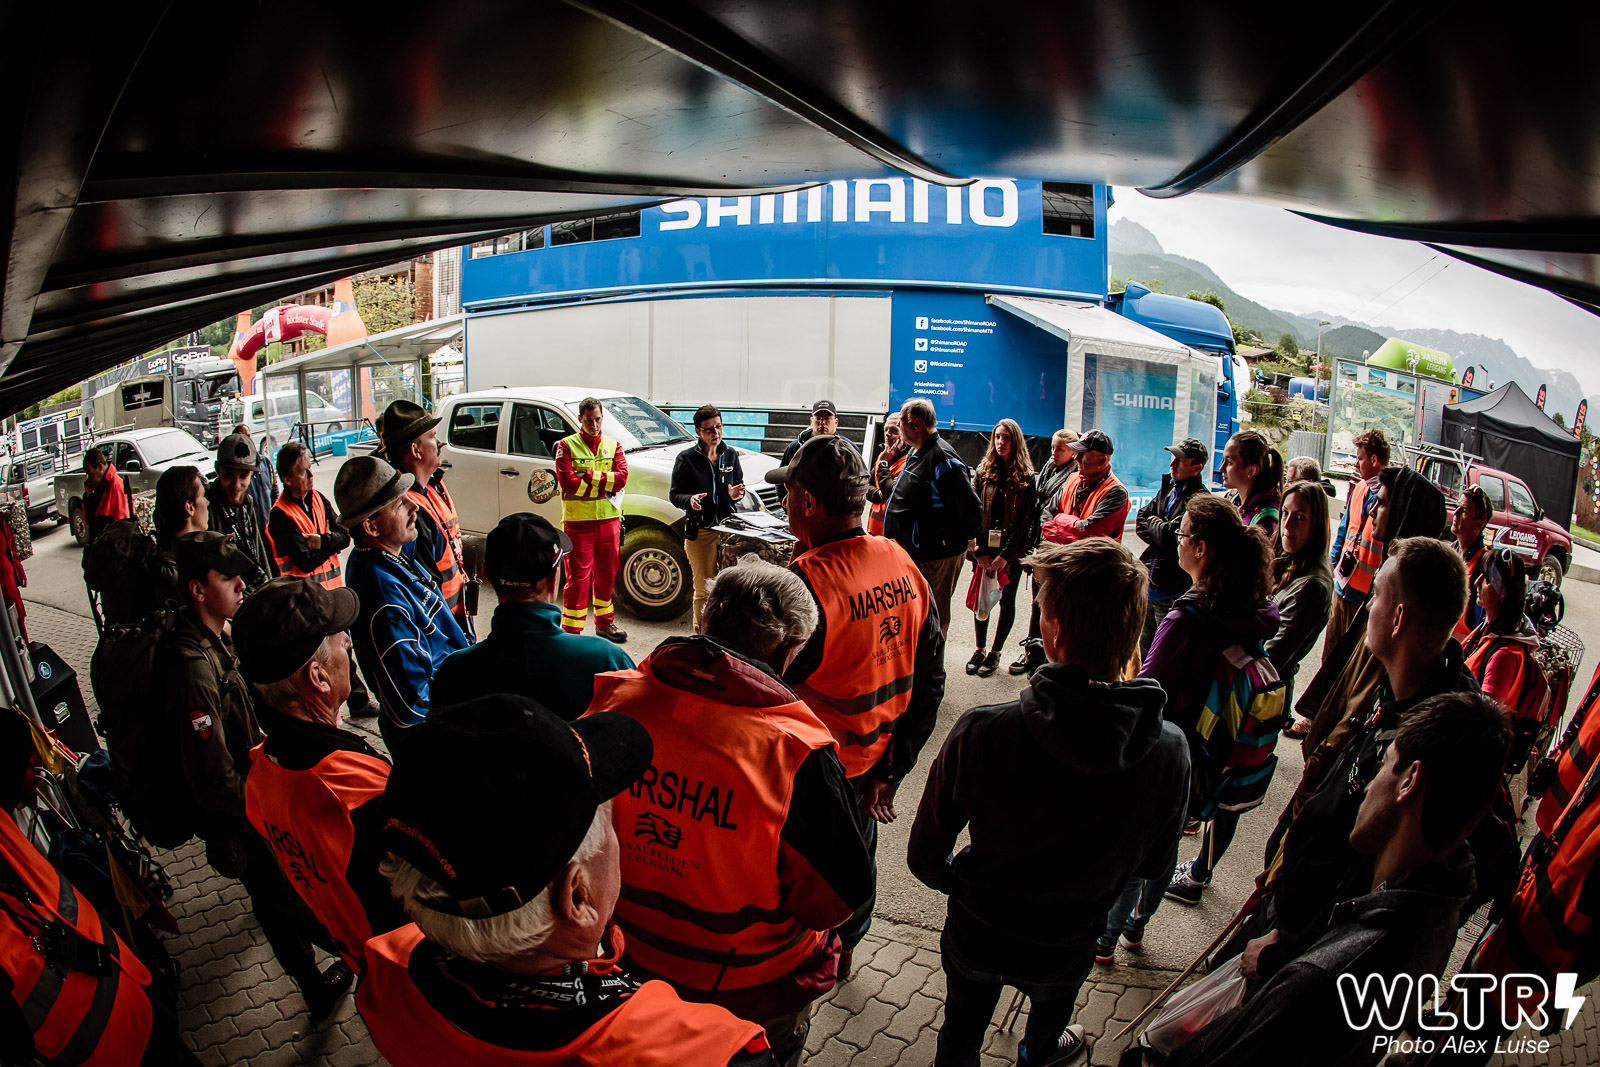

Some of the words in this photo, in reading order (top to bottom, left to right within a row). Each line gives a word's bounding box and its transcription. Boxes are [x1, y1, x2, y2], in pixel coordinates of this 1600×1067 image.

[147, 357, 168, 370] GoPro
[172, 351, 209, 362] GoPro
[848, 575, 917, 622] MARSHAL
[629, 765, 738, 830] RSHAL
[628, 852, 690, 881] LEOGANG
